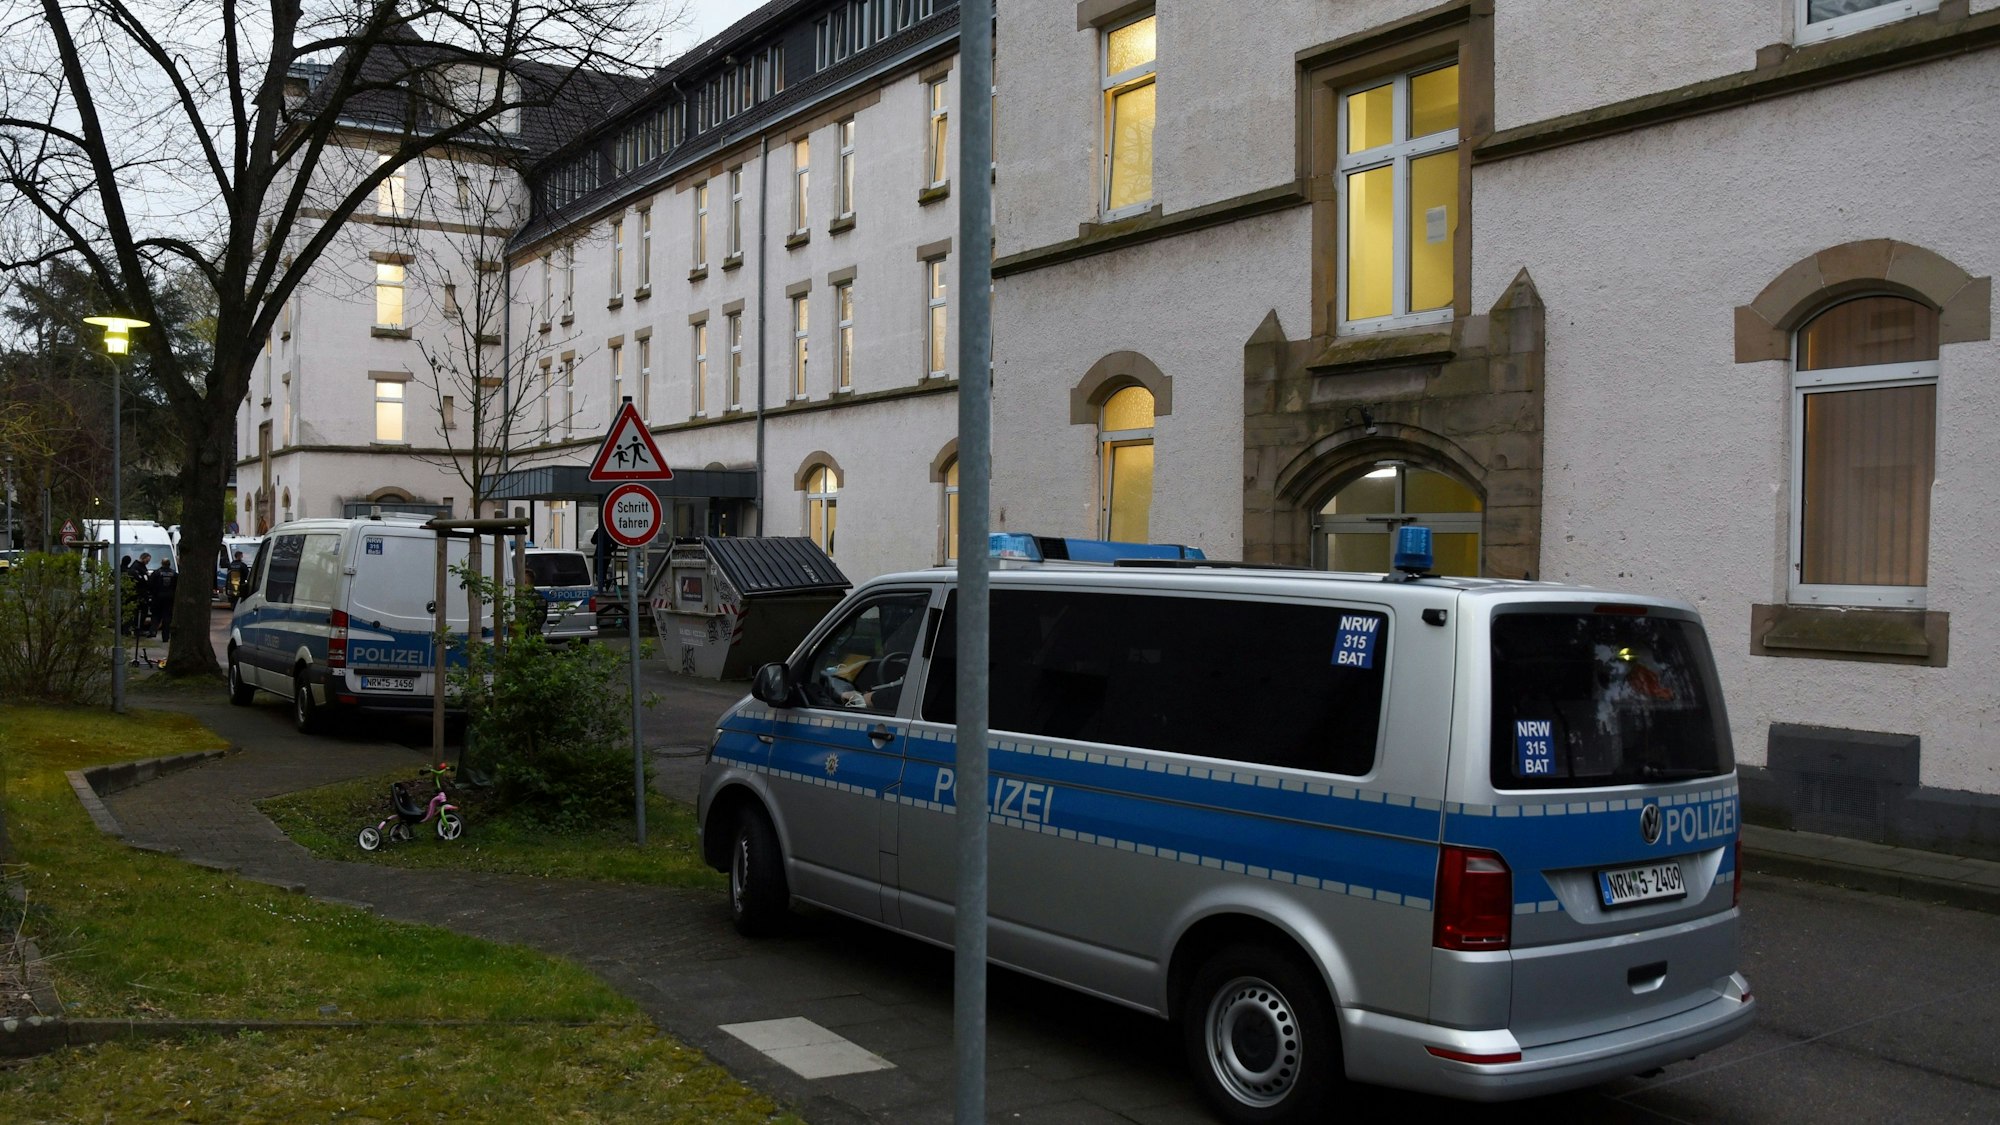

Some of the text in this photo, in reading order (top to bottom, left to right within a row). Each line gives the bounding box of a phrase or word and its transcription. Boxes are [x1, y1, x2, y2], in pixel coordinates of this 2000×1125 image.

[617, 501, 649, 513] Schritt
[618, 517, 649, 529] fahren
[557, 591, 590, 599] POLIZEI
[1340, 616, 1378, 633] NRW
[1343, 634, 1367, 649] 315
[353, 646, 424, 664] POLIZEI
[1337, 650, 1366, 666] BAT
[367, 678, 382, 687] NRW
[1517, 721, 1550, 737] NRW
[1526, 741, 1547, 755] 315
[1525, 759, 1549, 773] BAT
[934, 767, 1054, 824] PIZEI
[1666, 800, 1736, 845] POLIZEI
[1608, 866, 1682, 899] NRW 5-2409
